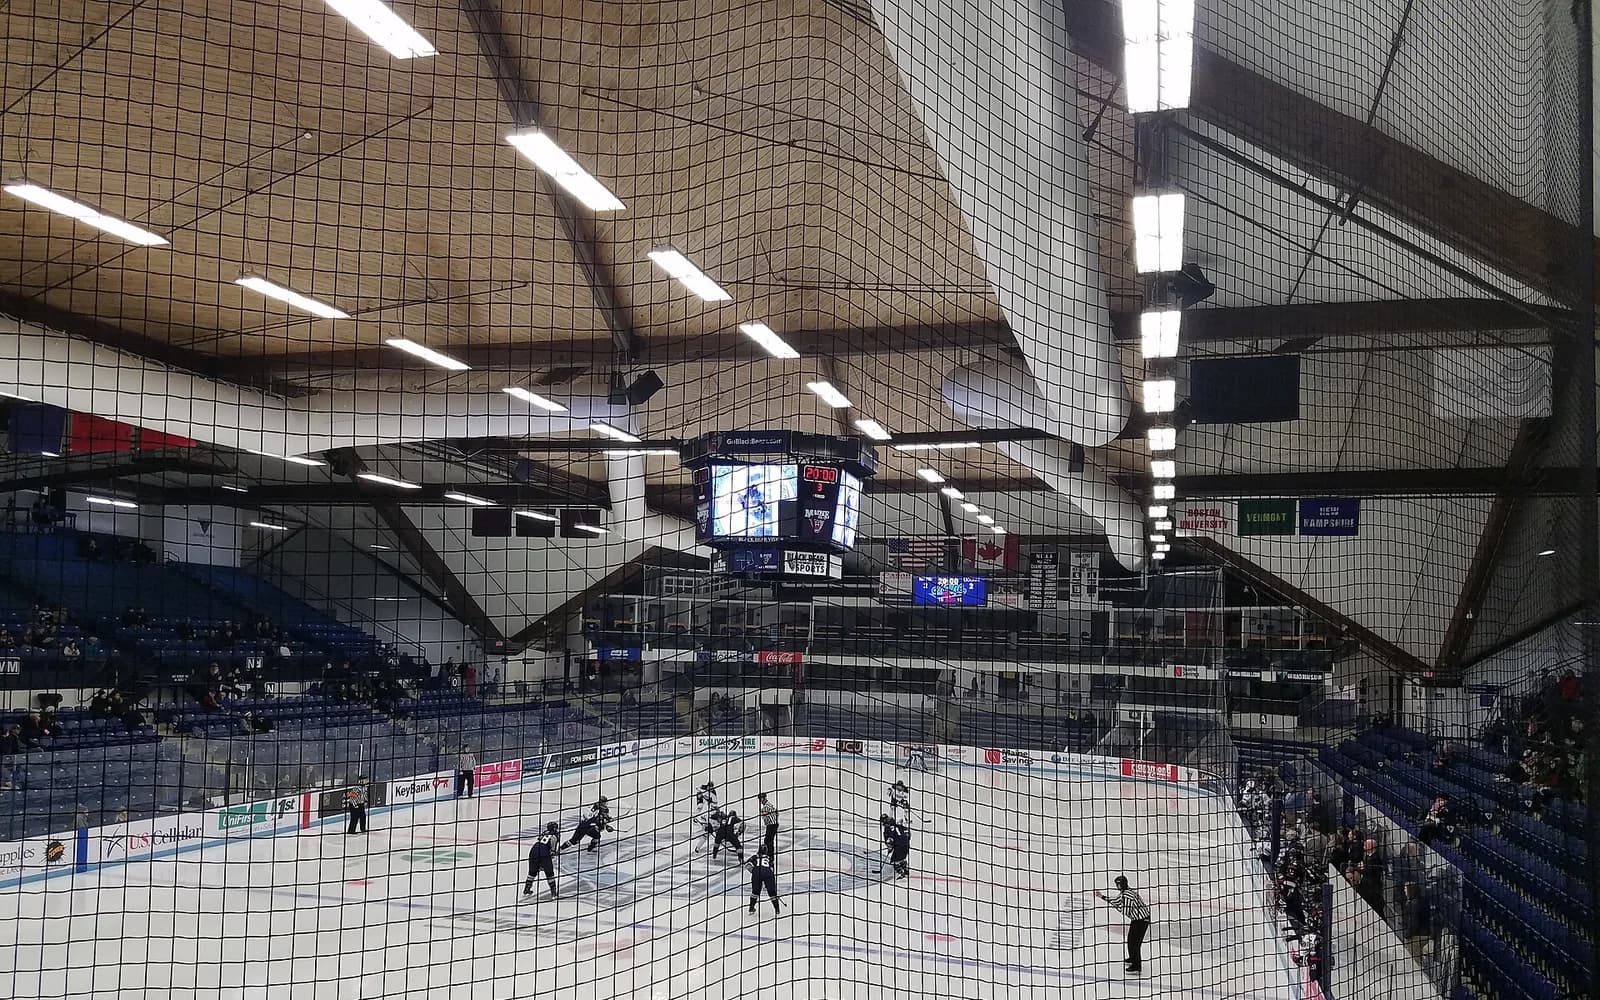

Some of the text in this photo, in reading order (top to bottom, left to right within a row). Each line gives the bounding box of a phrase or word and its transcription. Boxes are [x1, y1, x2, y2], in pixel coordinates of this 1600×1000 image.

[806, 468, 835, 481] 20:00
[1319, 506, 1339, 516] NEW
[1246, 512, 1288, 522] VERMONT
[1179, 520, 1229, 529] UNIVERSITY
[1303, 518, 1355, 528] HAMPSHIRE
[796, 564, 825, 574] SPORTS
[601, 745, 627, 760] GEICO
[395, 781, 432, 798] KeyBank
[222, 812, 256, 827] UniFirst
[152, 825, 203, 846] Cellular
